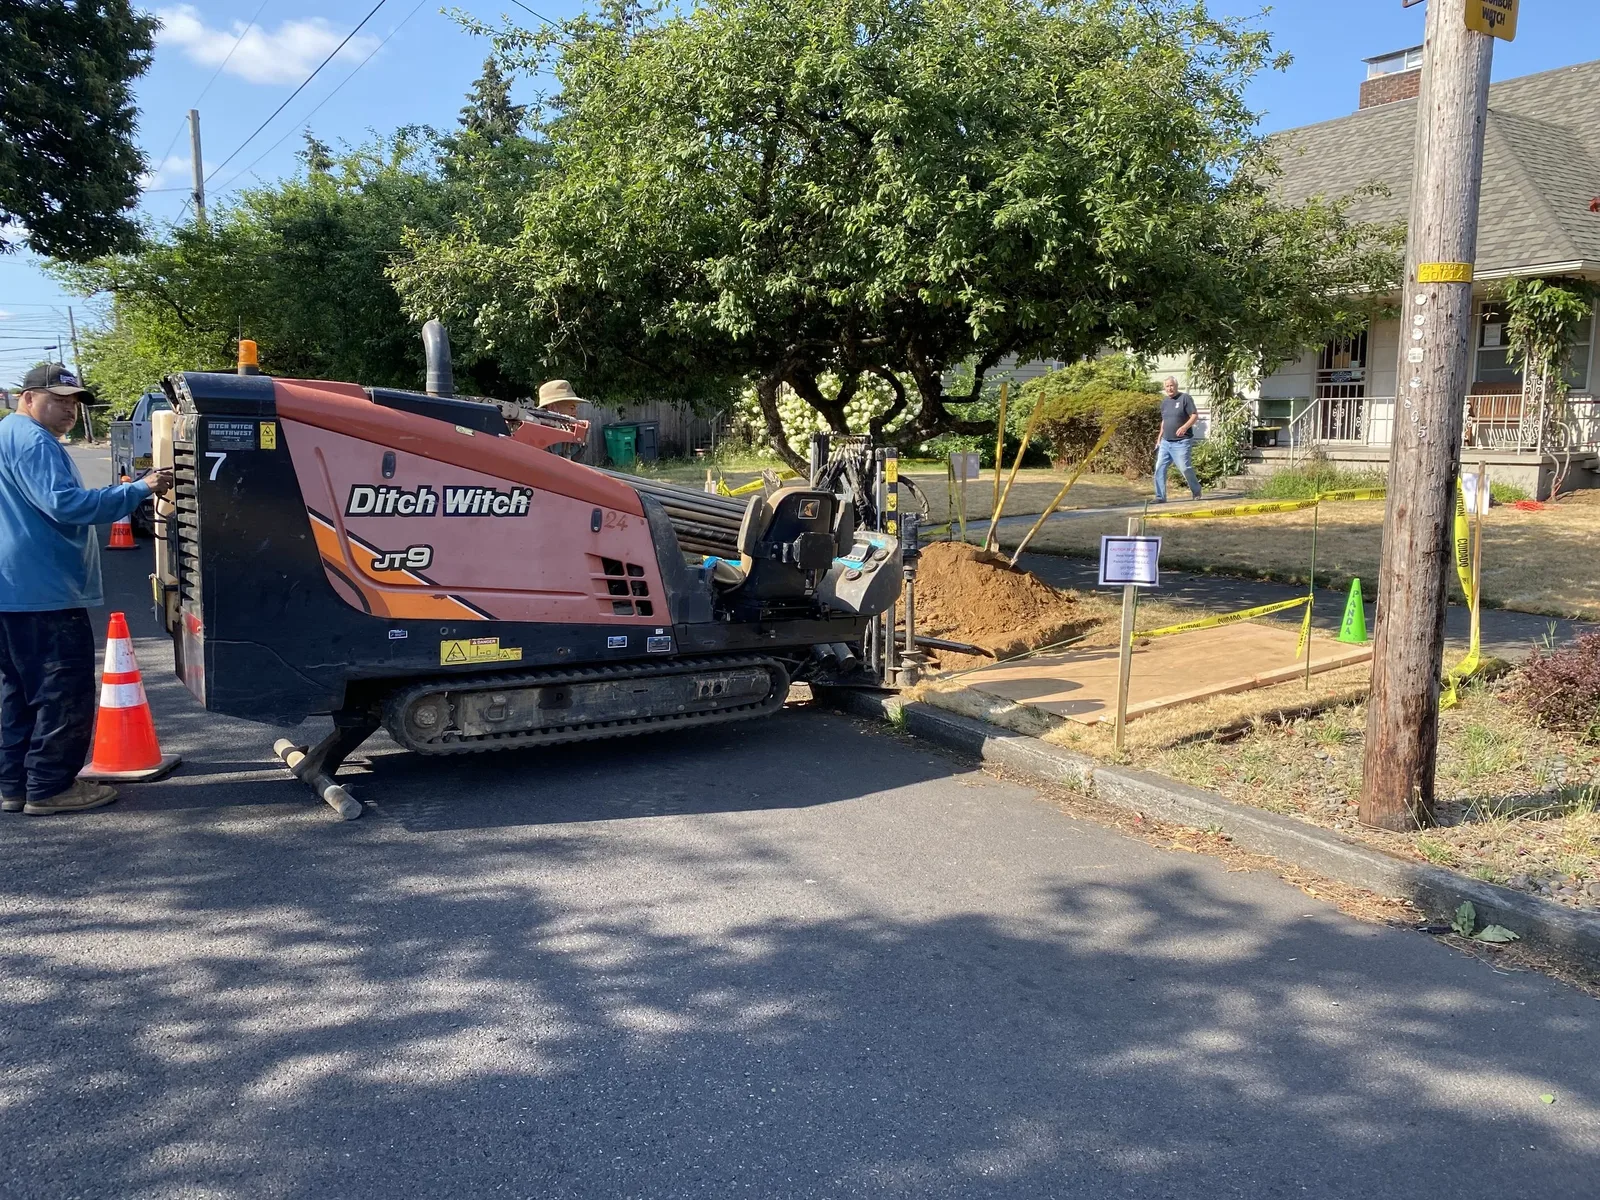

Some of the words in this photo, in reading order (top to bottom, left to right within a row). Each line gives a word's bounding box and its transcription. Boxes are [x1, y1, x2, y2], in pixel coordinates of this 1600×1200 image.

[1482, 6, 1506, 26] WATCH
[205, 451, 227, 481] 7
[348, 487, 436, 514] Ditch
[445, 488, 528, 514] Witch
[1456, 487, 1466, 517] CAUTION
[604, 511, 629, 531] 24
[373, 547, 431, 569] JT9
[1457, 538, 1469, 568] CUIDADO
[1345, 590, 1360, 635] PANDA
